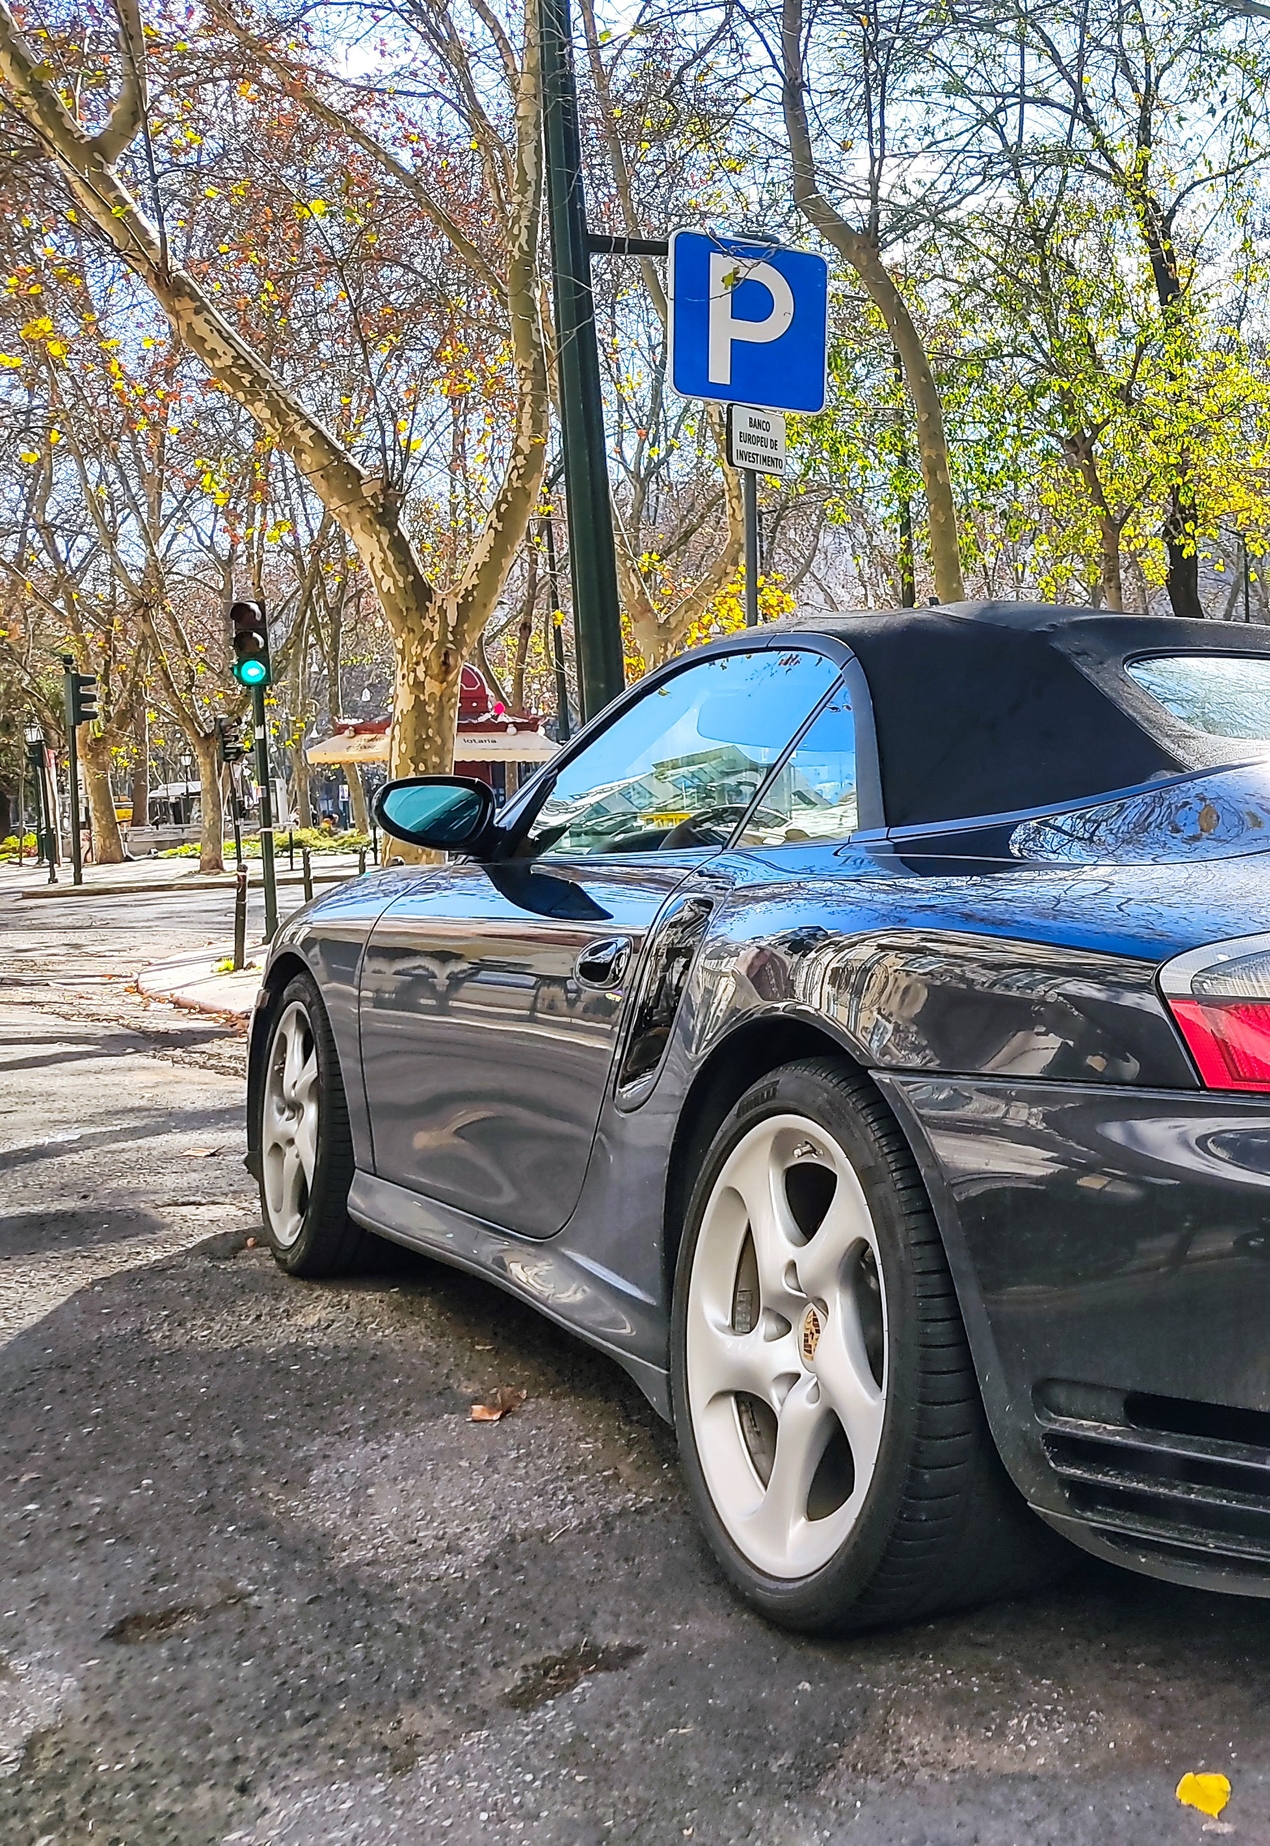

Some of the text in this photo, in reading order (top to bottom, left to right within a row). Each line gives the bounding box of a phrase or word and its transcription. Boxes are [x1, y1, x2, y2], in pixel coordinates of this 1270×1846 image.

[708, 252, 795, 385] P
[748, 416, 771, 433] BANCO
[739, 431, 779, 451] EUROPEU DE
[736, 448, 783, 470] INVESTIMENTO
